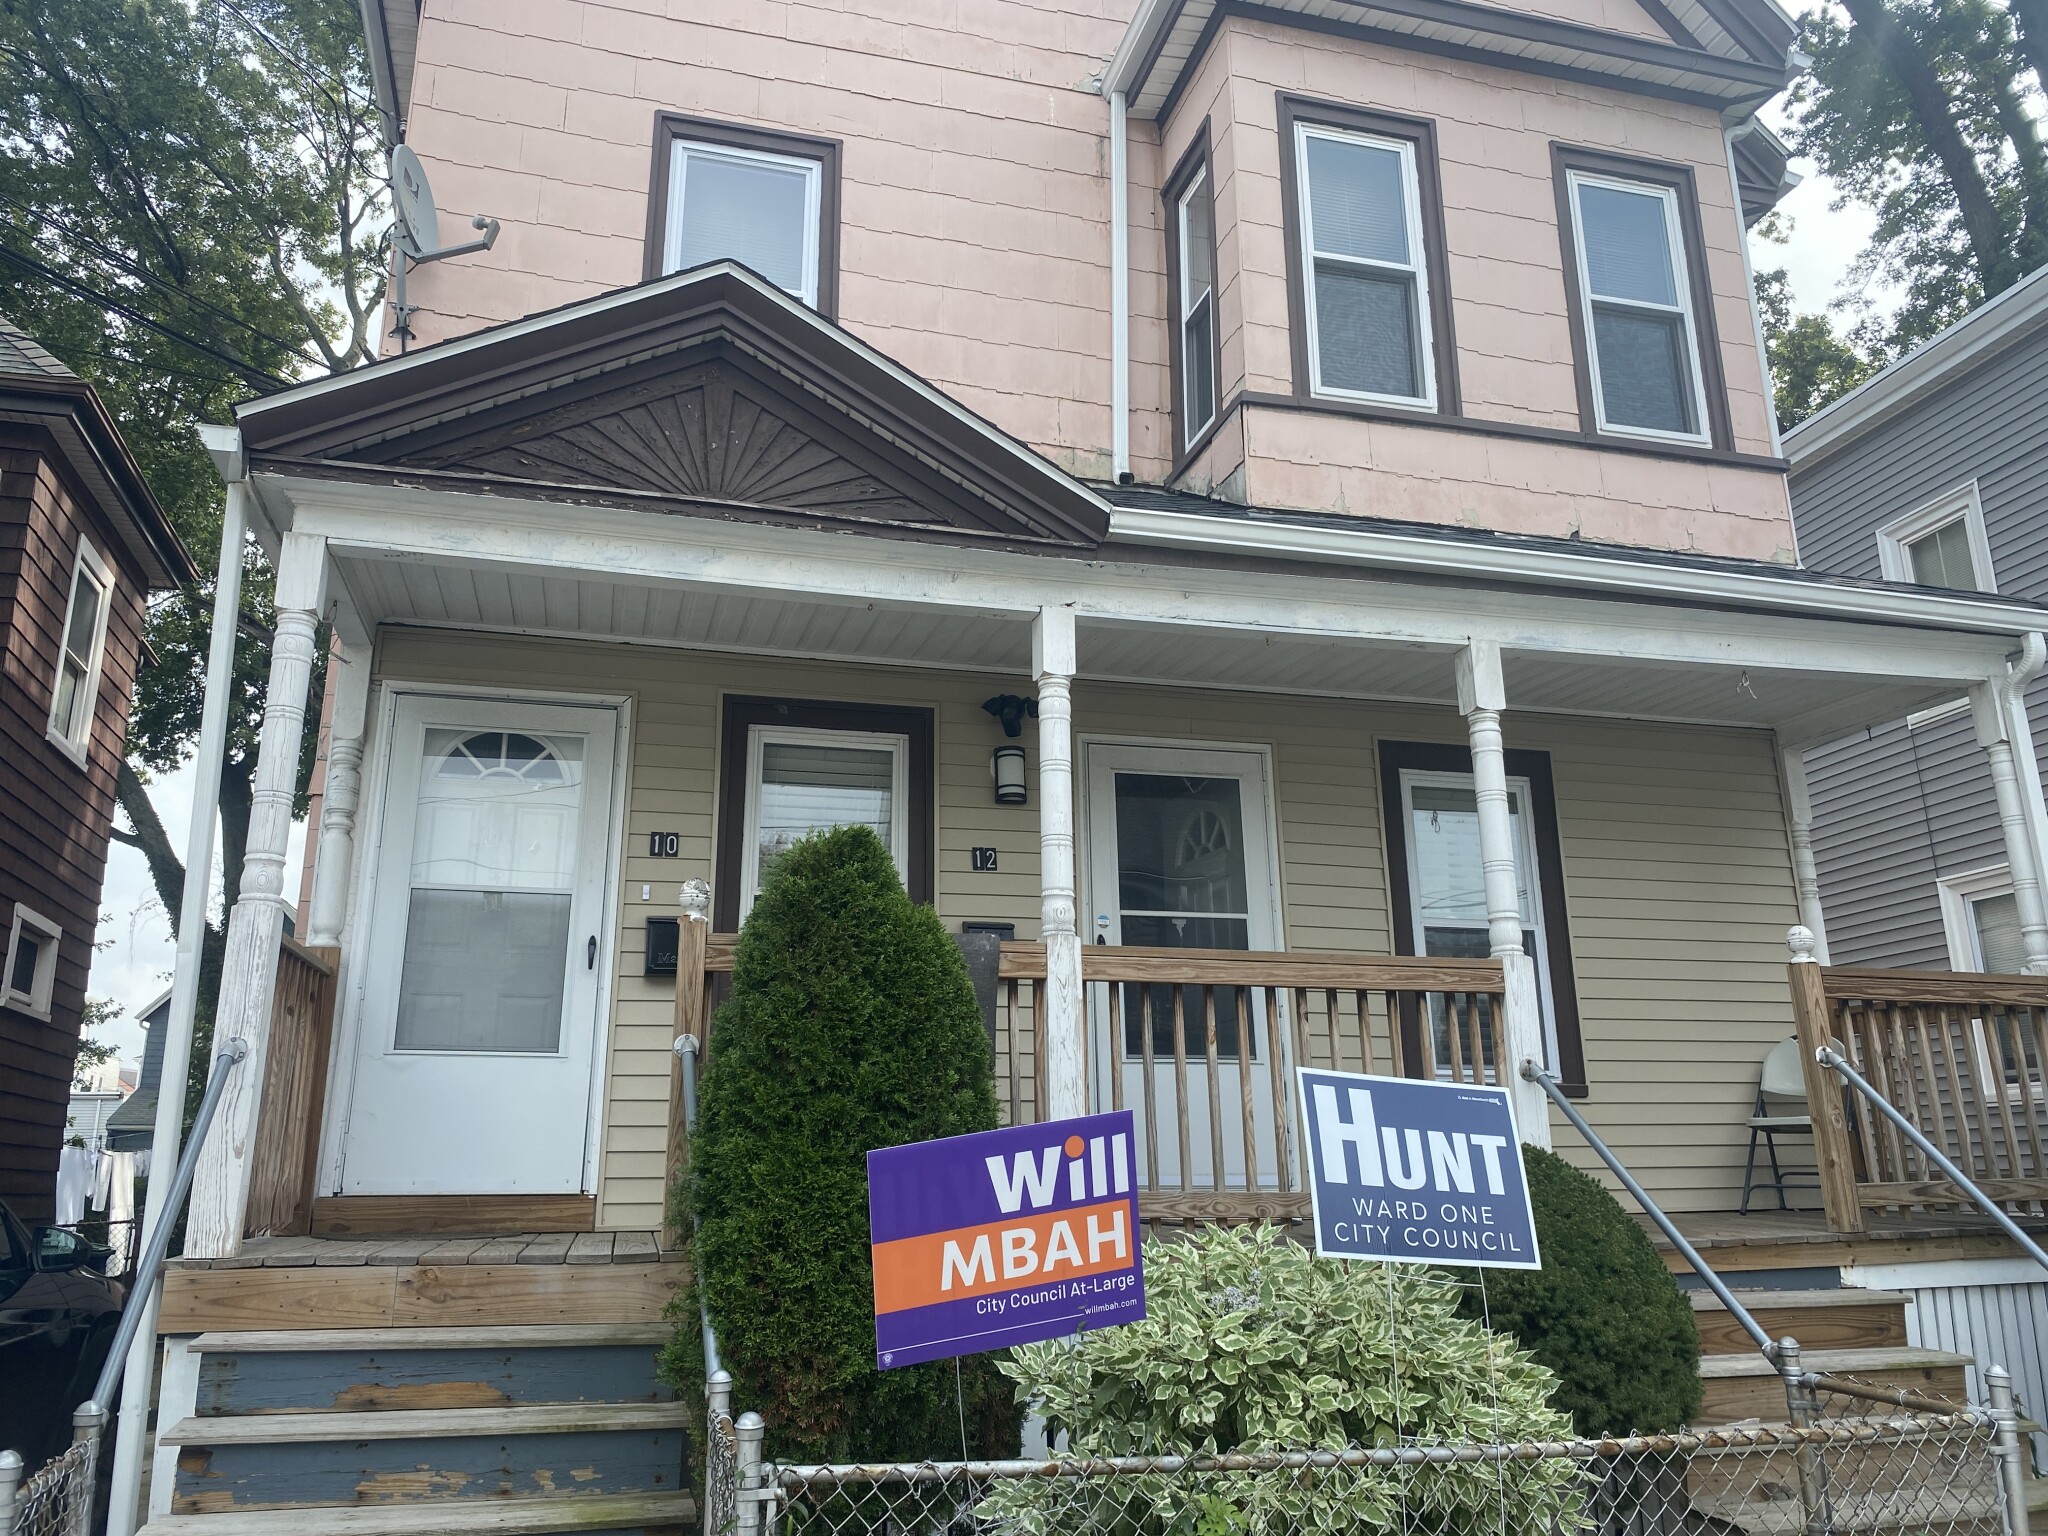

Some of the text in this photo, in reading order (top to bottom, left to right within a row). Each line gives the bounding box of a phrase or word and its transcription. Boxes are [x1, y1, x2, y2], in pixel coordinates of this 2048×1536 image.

[654, 835, 677, 853] 10
[975, 850, 995, 868] 12
[657, 952, 677, 964] Ma
[1312, 1083, 1507, 1196] HUNT
[985, 1132, 1130, 1214] Will
[1352, 1197, 1495, 1225] WARD ONE
[940, 1209, 1127, 1291] MBAH
[1334, 1222, 1521, 1252] CITY COUNCIL
[976, 1274, 1135, 1315] City Council At-Large
[1084, 1298, 1138, 1315] willmbah.com
